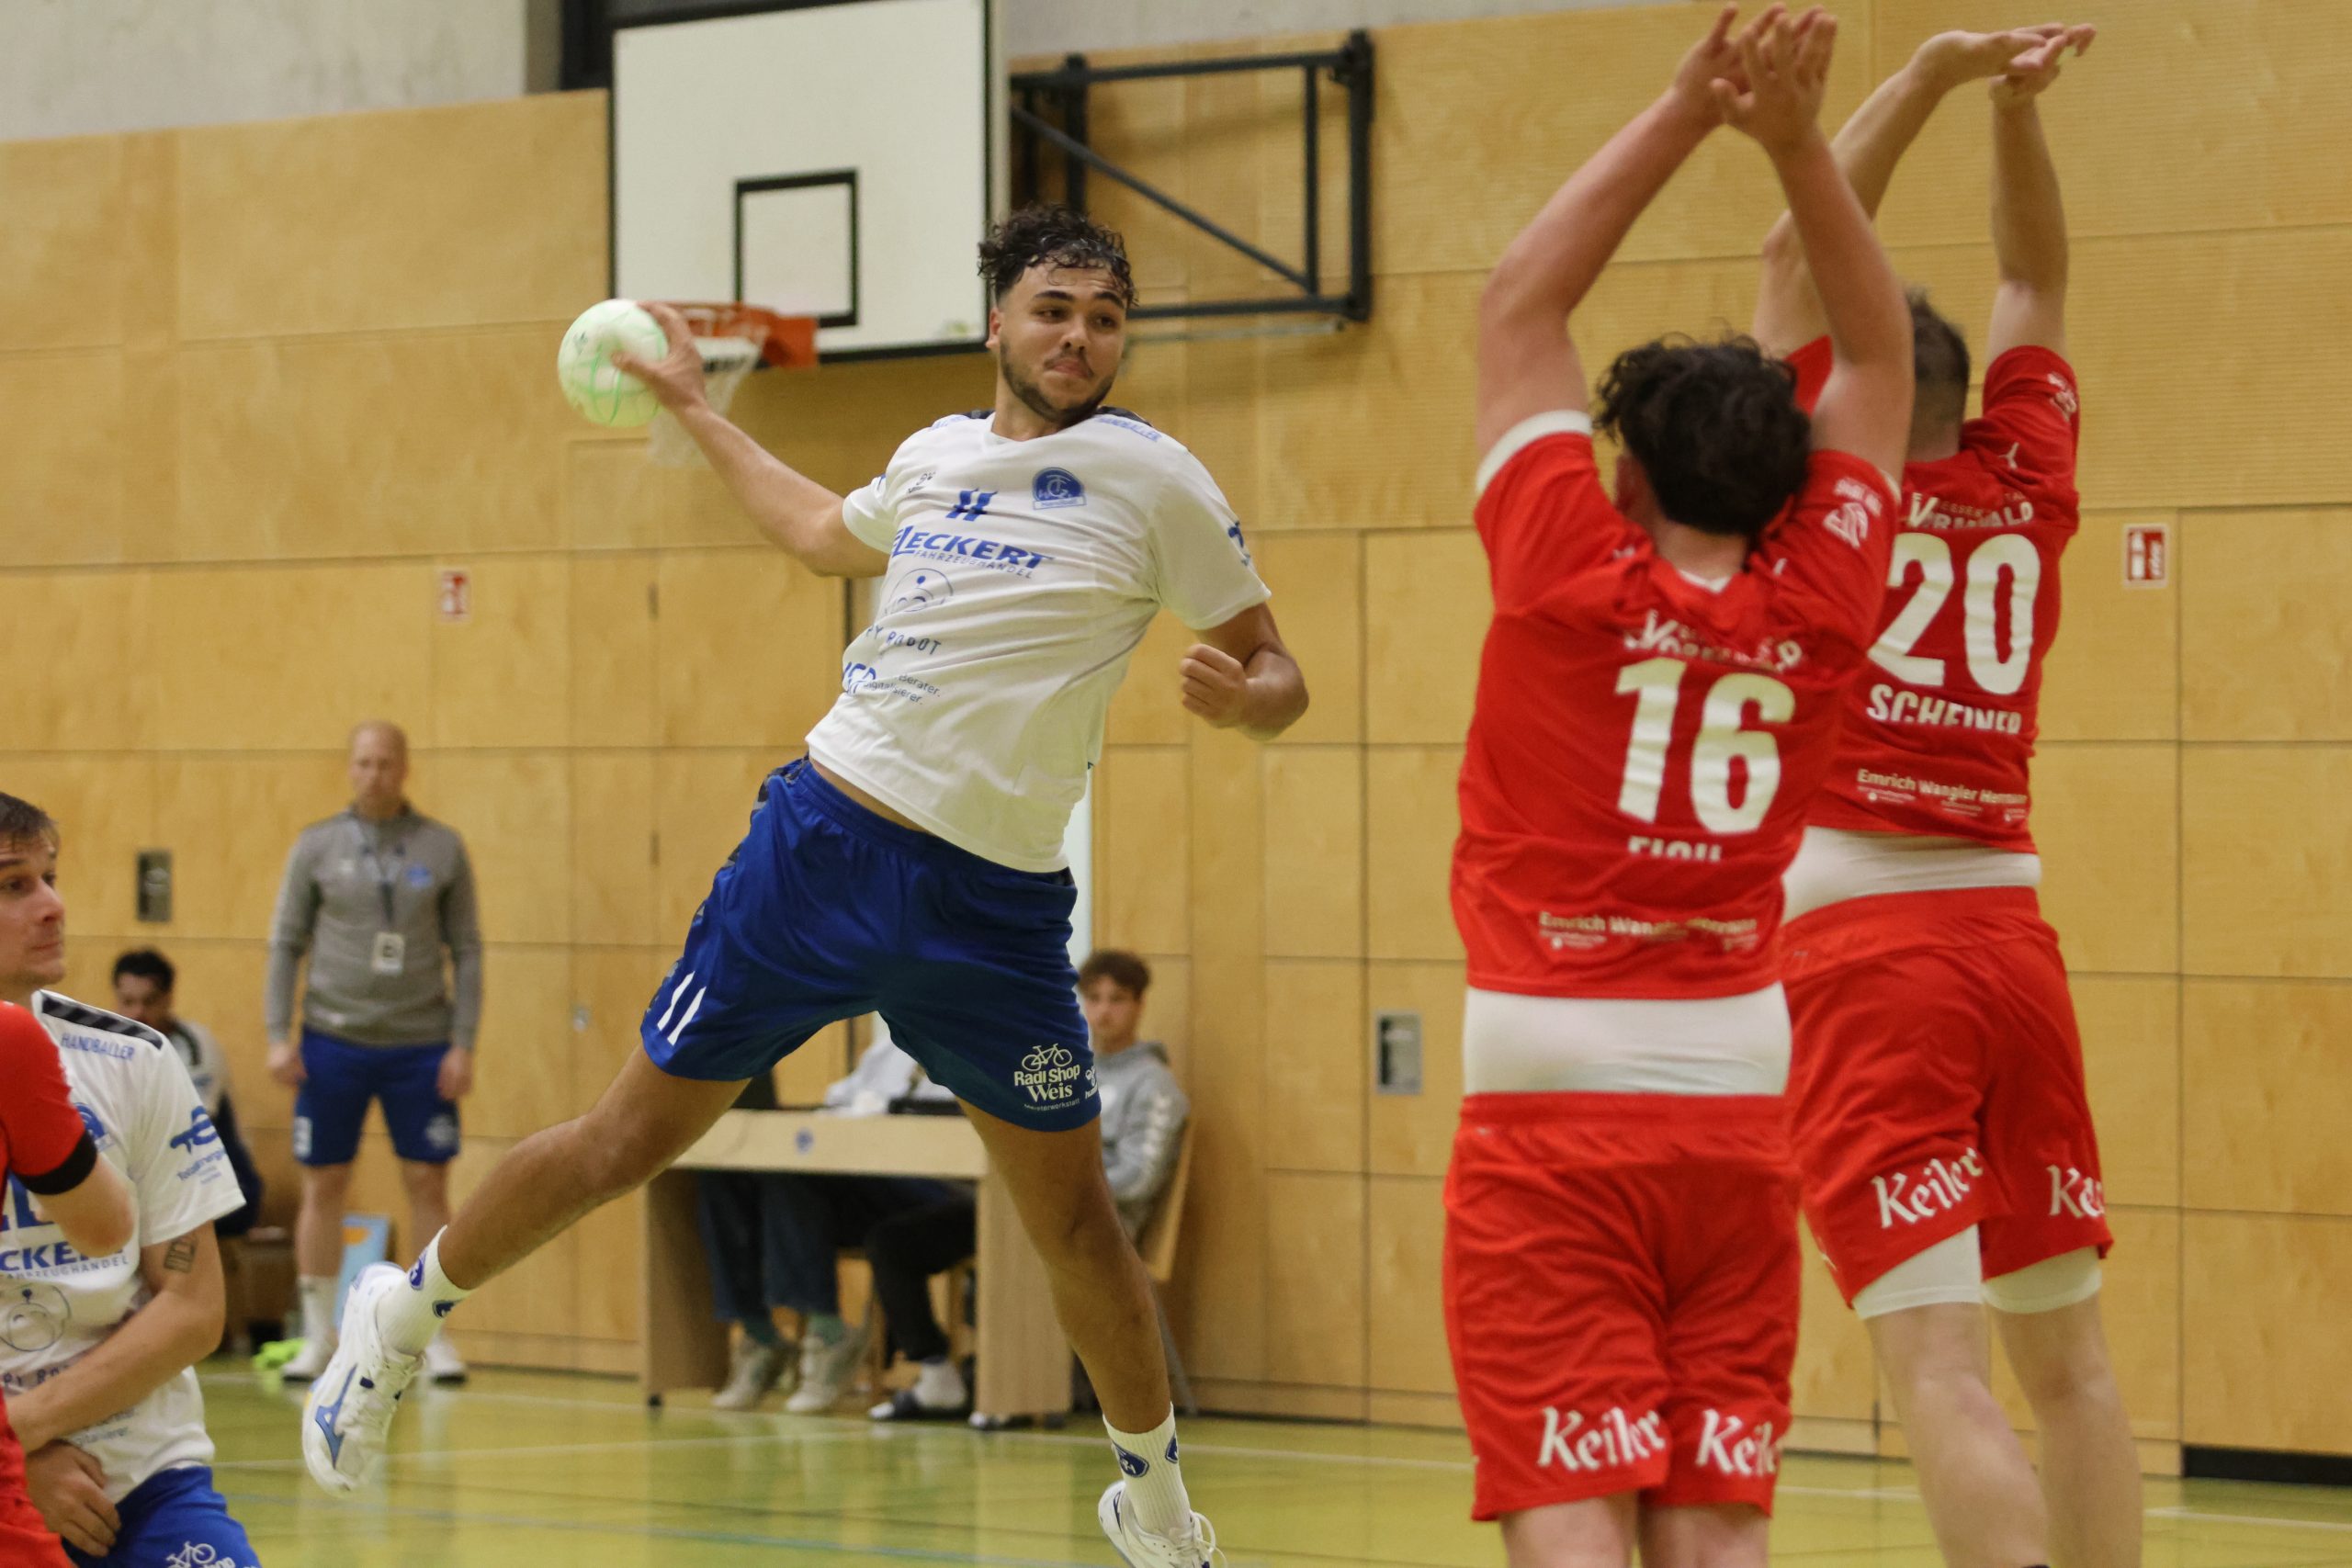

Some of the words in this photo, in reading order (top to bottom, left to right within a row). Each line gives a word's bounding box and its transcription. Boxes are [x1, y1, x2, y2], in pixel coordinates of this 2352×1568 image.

[892, 525, 1055, 570] LECKERT
[913, 549, 1033, 580] FAHRZEUGHANDEL
[1867, 532, 2041, 695] 20
[1866, 683, 2023, 735] SCHEINER
[1615, 656, 1796, 835] 16
[1857, 769, 1917, 791] Emrich
[657, 970, 707, 1046] 11
[1013, 1070, 1047, 1087] Radl
[1048, 1064, 1080, 1083] Shop
[1027, 1082, 1073, 1103] Weis
[1871, 1146, 1984, 1229] Keiler
[1537, 1405, 1666, 1471] Keiler
